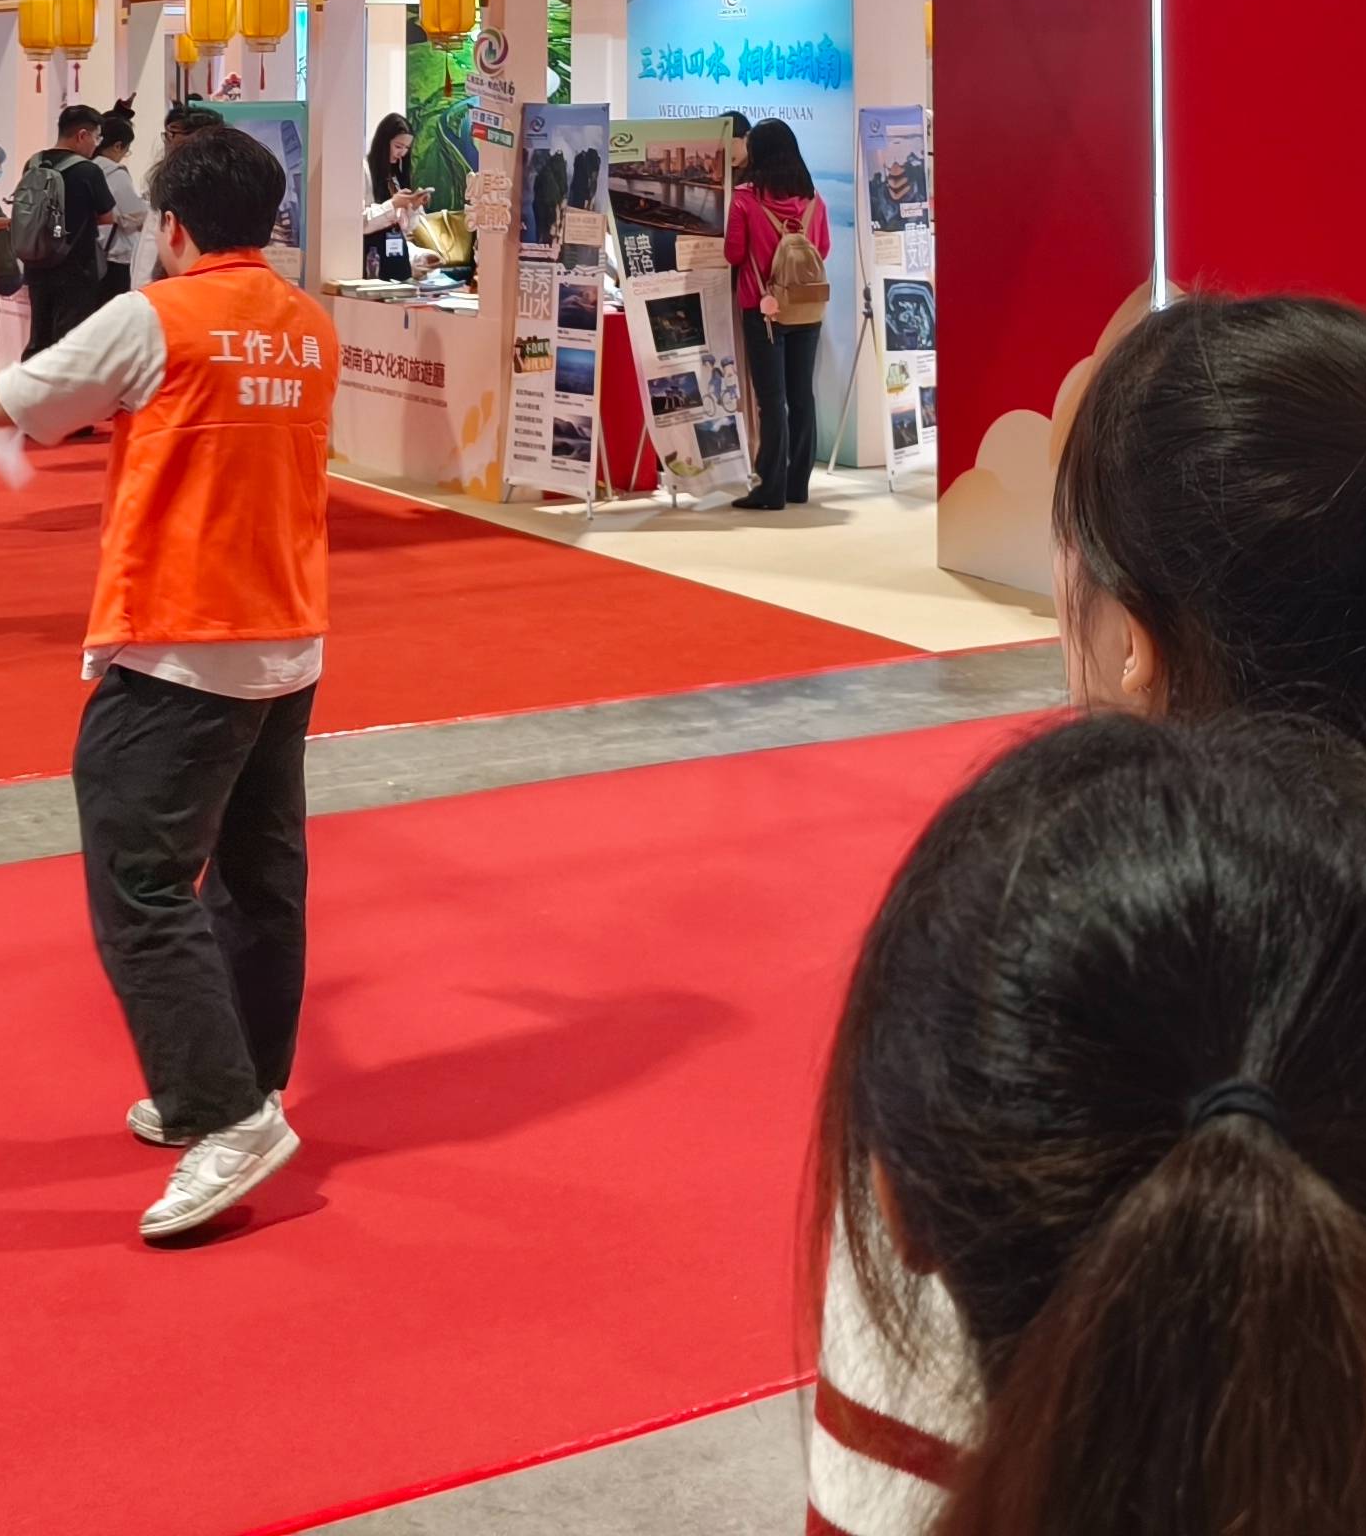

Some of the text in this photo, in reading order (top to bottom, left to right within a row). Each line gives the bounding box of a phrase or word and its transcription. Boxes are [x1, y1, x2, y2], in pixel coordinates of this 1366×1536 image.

[658, 104, 703, 119] WELCOME
[778, 105, 814, 121] HUNAN
[209, 330, 322, 370] 工作人員
[239, 375, 303, 408] STAFF
